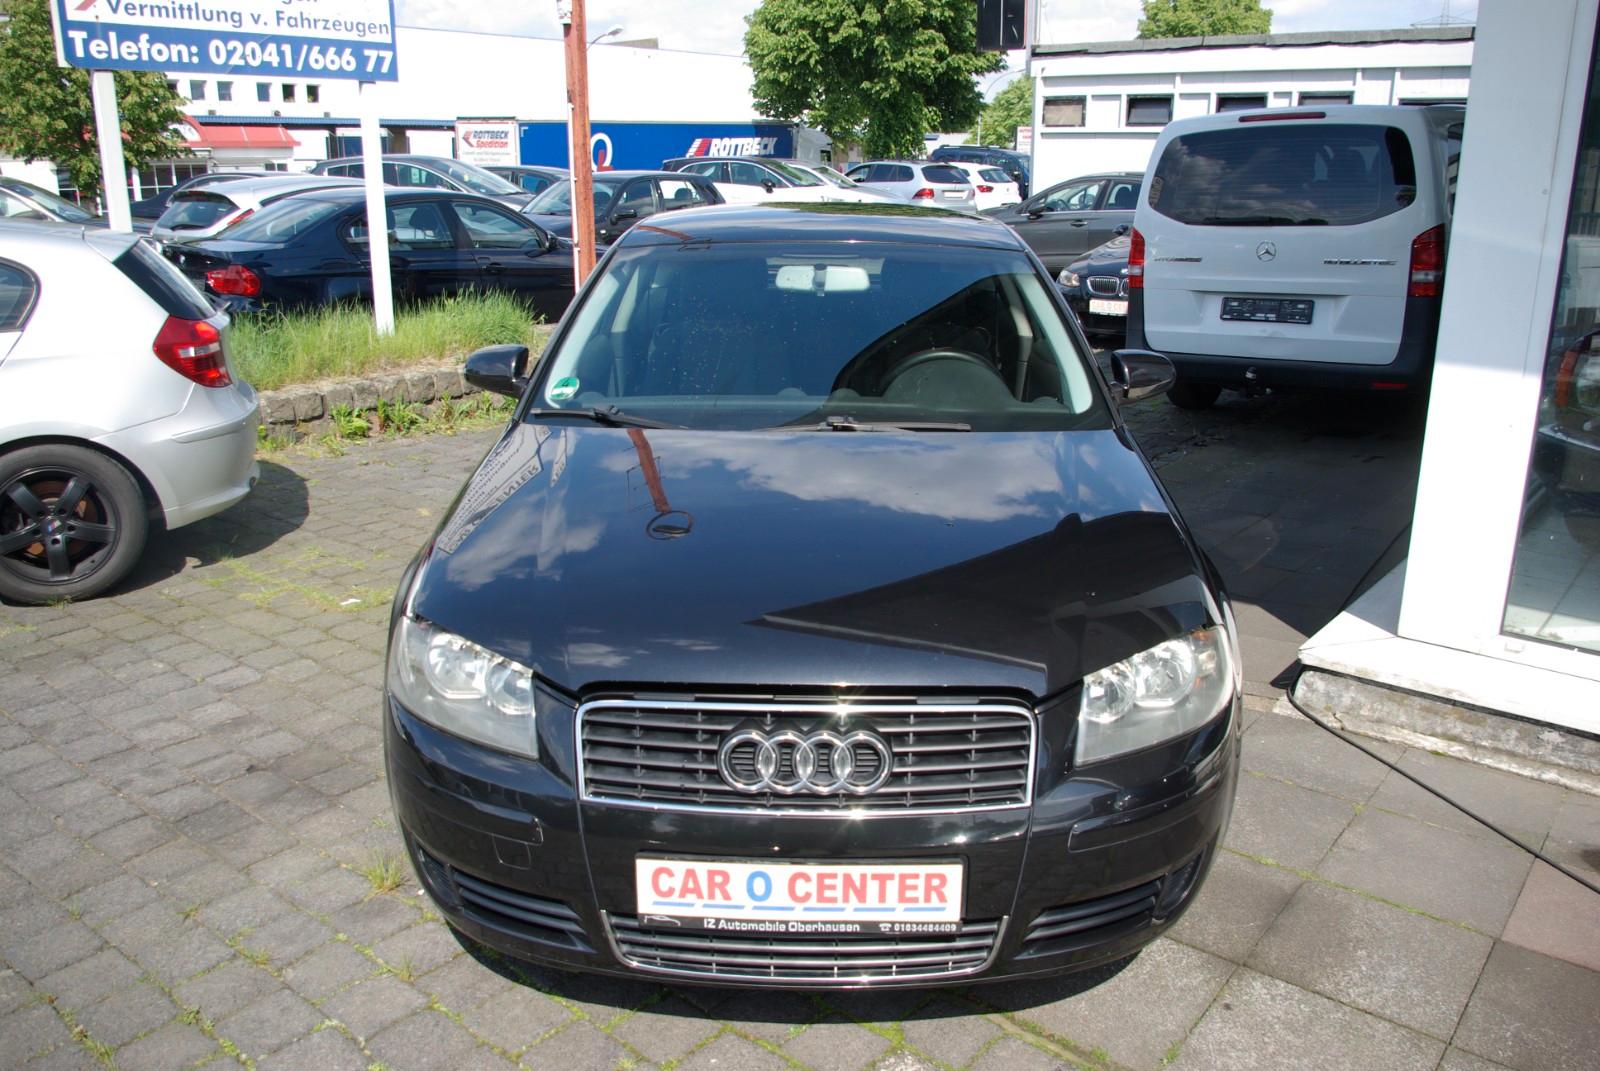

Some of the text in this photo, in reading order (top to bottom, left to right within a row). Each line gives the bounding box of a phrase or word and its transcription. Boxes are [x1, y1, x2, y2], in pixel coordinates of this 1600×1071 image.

[107, 0, 390, 37] Vermittlung v. Fahrzeugen
[68, 31, 393, 73] Telefon: 02041/666 77
[708, 137, 777, 157] ROTTBECK
[651, 867, 948, 904] CAR O CENTER
[718, 919, 786, 932] Automobile
[788, 922, 861, 933] Oberhausen
